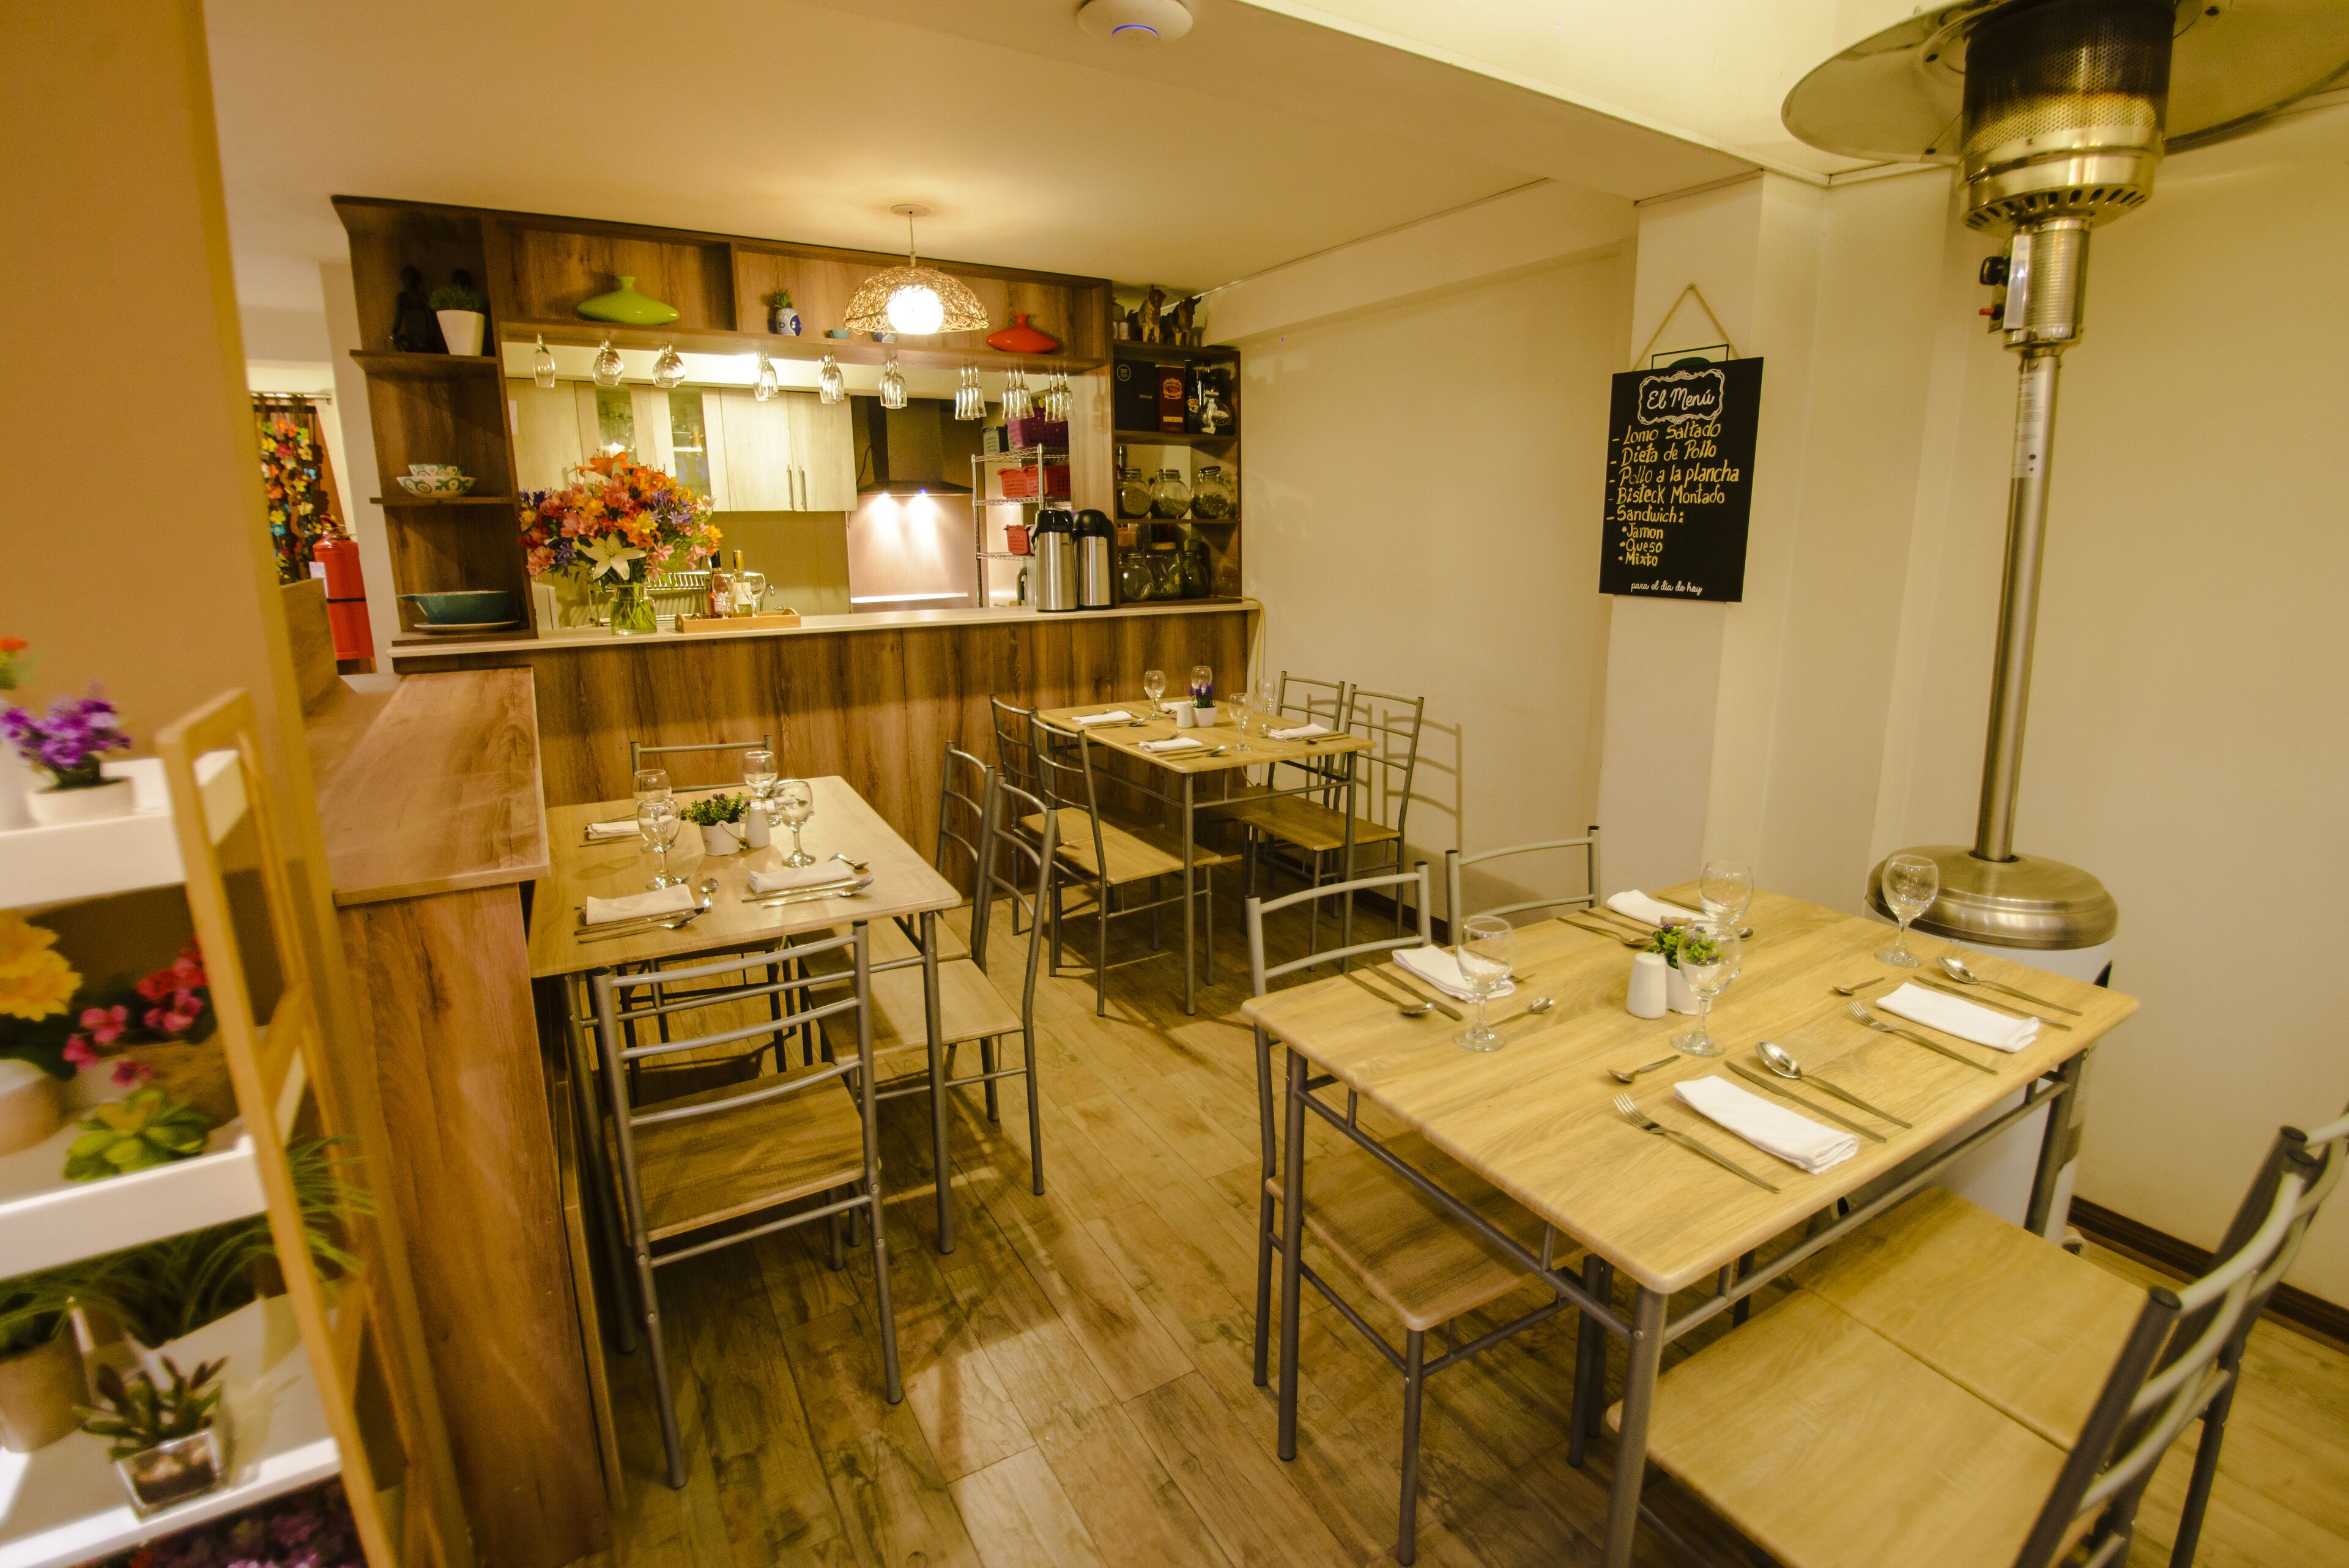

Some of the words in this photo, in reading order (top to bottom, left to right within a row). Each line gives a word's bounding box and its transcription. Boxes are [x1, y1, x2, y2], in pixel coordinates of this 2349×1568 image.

[1647, 389, 1666, 409] El
[1670, 387, 1715, 411] Menú
[1666, 418, 1721, 440] Saltado
[1621, 443, 1658, 467] Dieta
[1663, 442, 1678, 461] de
[1684, 439, 1717, 459] Pollo
[1619, 466, 1652, 486] Pollo
[1656, 469, 1665, 483] a
[1670, 464, 1682, 482] la
[1685, 459, 1740, 488] plancha
[1670, 483, 1725, 504] Montado
[1627, 523, 1664, 540] Jamon
[1625, 538, 1663, 553] Queso
[1625, 552, 1658, 567] Mixto
[1631, 582, 1649, 592] para
[1651, 580, 1659, 590] el
[1675, 581, 1685, 592] de
[1687, 582, 1703, 596] hoy
